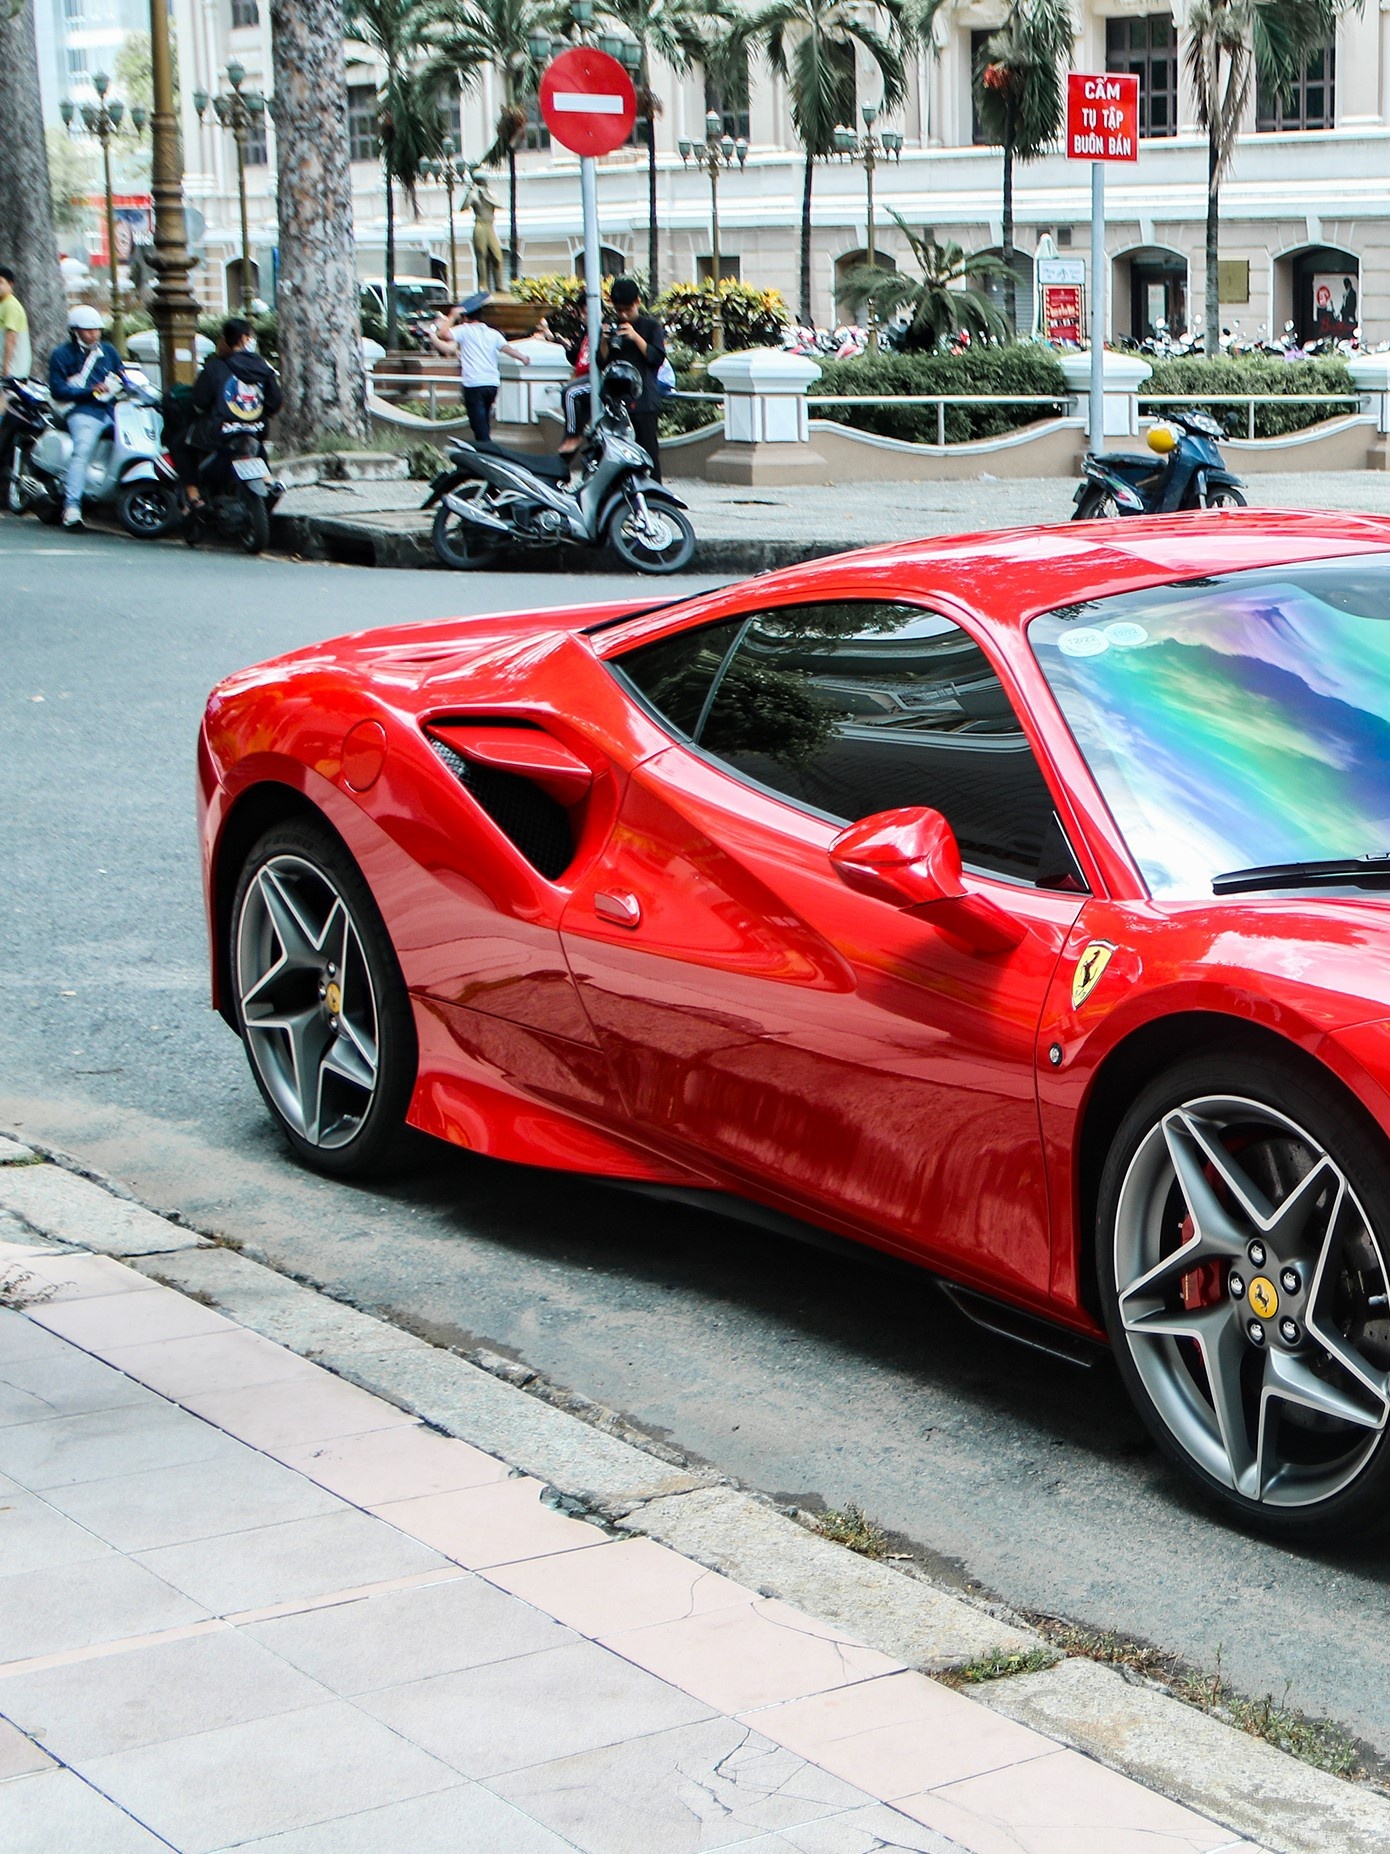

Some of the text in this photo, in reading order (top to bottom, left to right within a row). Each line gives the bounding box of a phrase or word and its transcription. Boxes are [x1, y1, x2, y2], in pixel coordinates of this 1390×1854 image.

[1084, 76, 1121, 101] CẤM
[1081, 105, 1124, 132] TỤ TẬP
[1073, 131, 1131, 156] BUÔN BÁN
